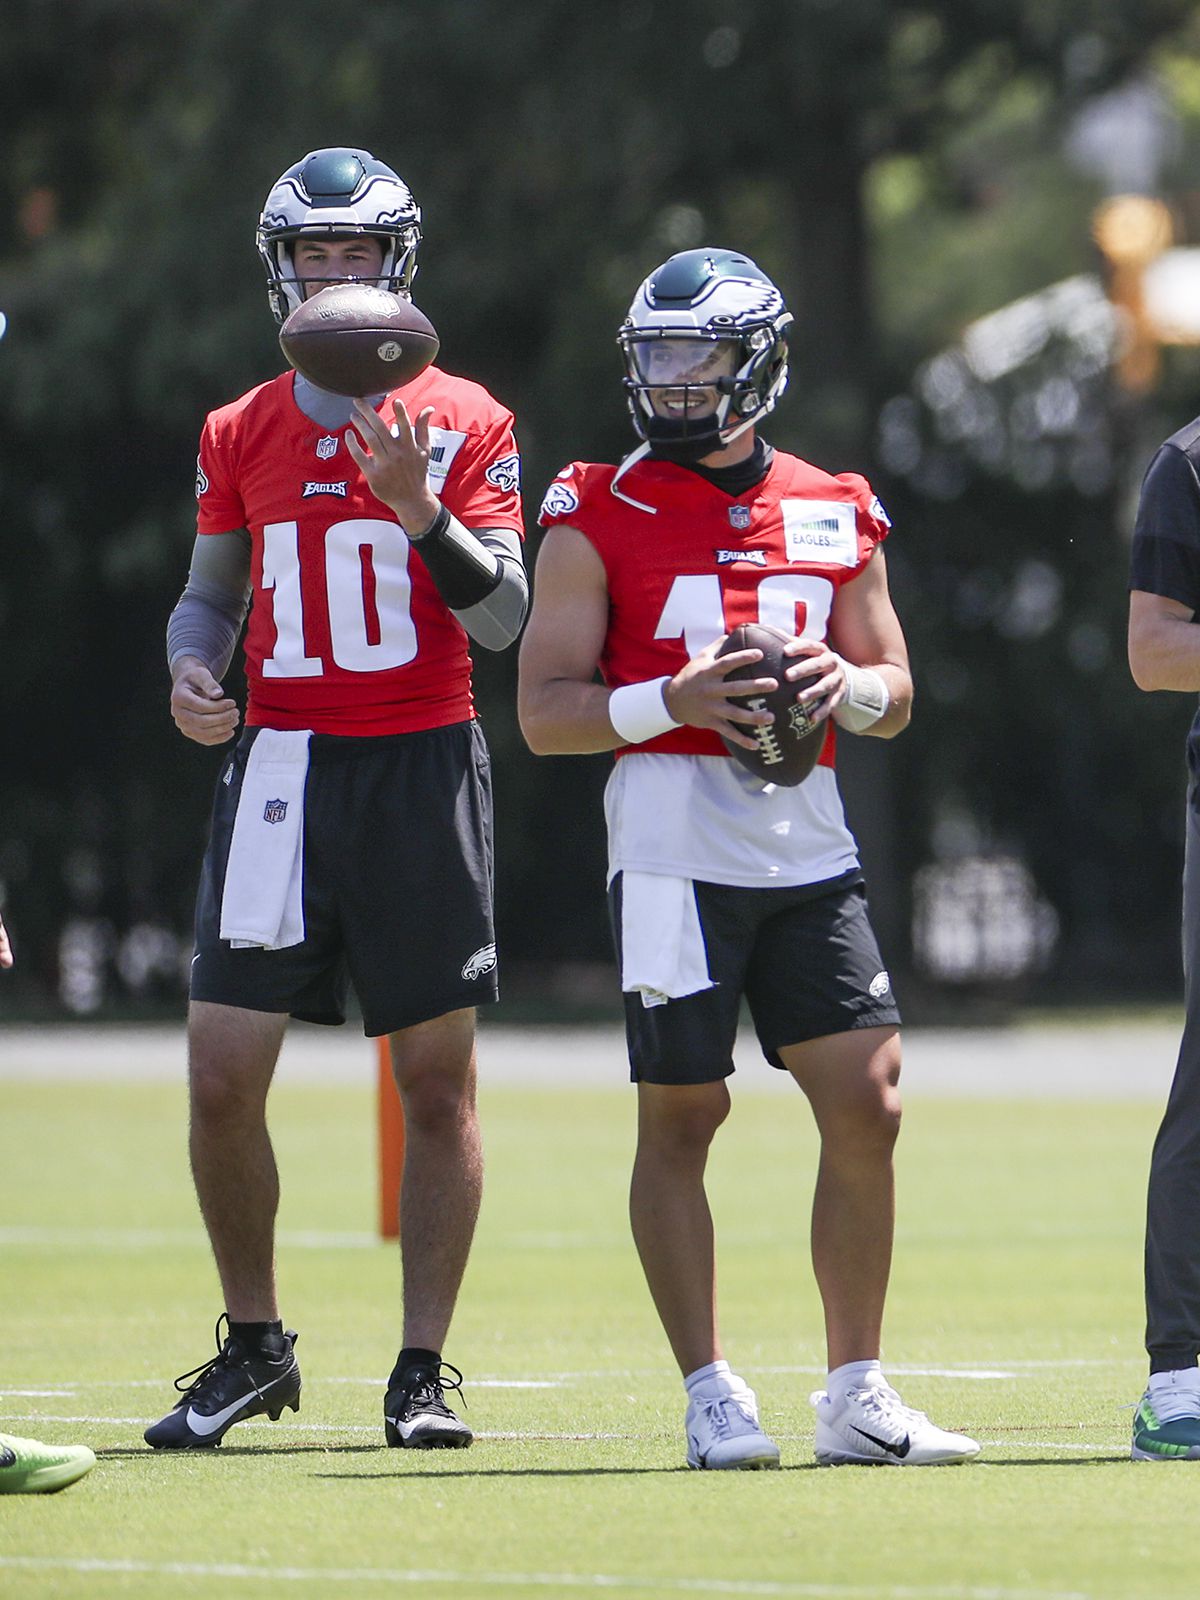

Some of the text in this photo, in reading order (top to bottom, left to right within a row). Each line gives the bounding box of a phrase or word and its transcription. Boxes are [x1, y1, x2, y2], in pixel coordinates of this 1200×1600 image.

[303, 481, 348, 498] EAGLES
[792, 533, 830, 547] EAGLES
[261, 519, 419, 678] 10
